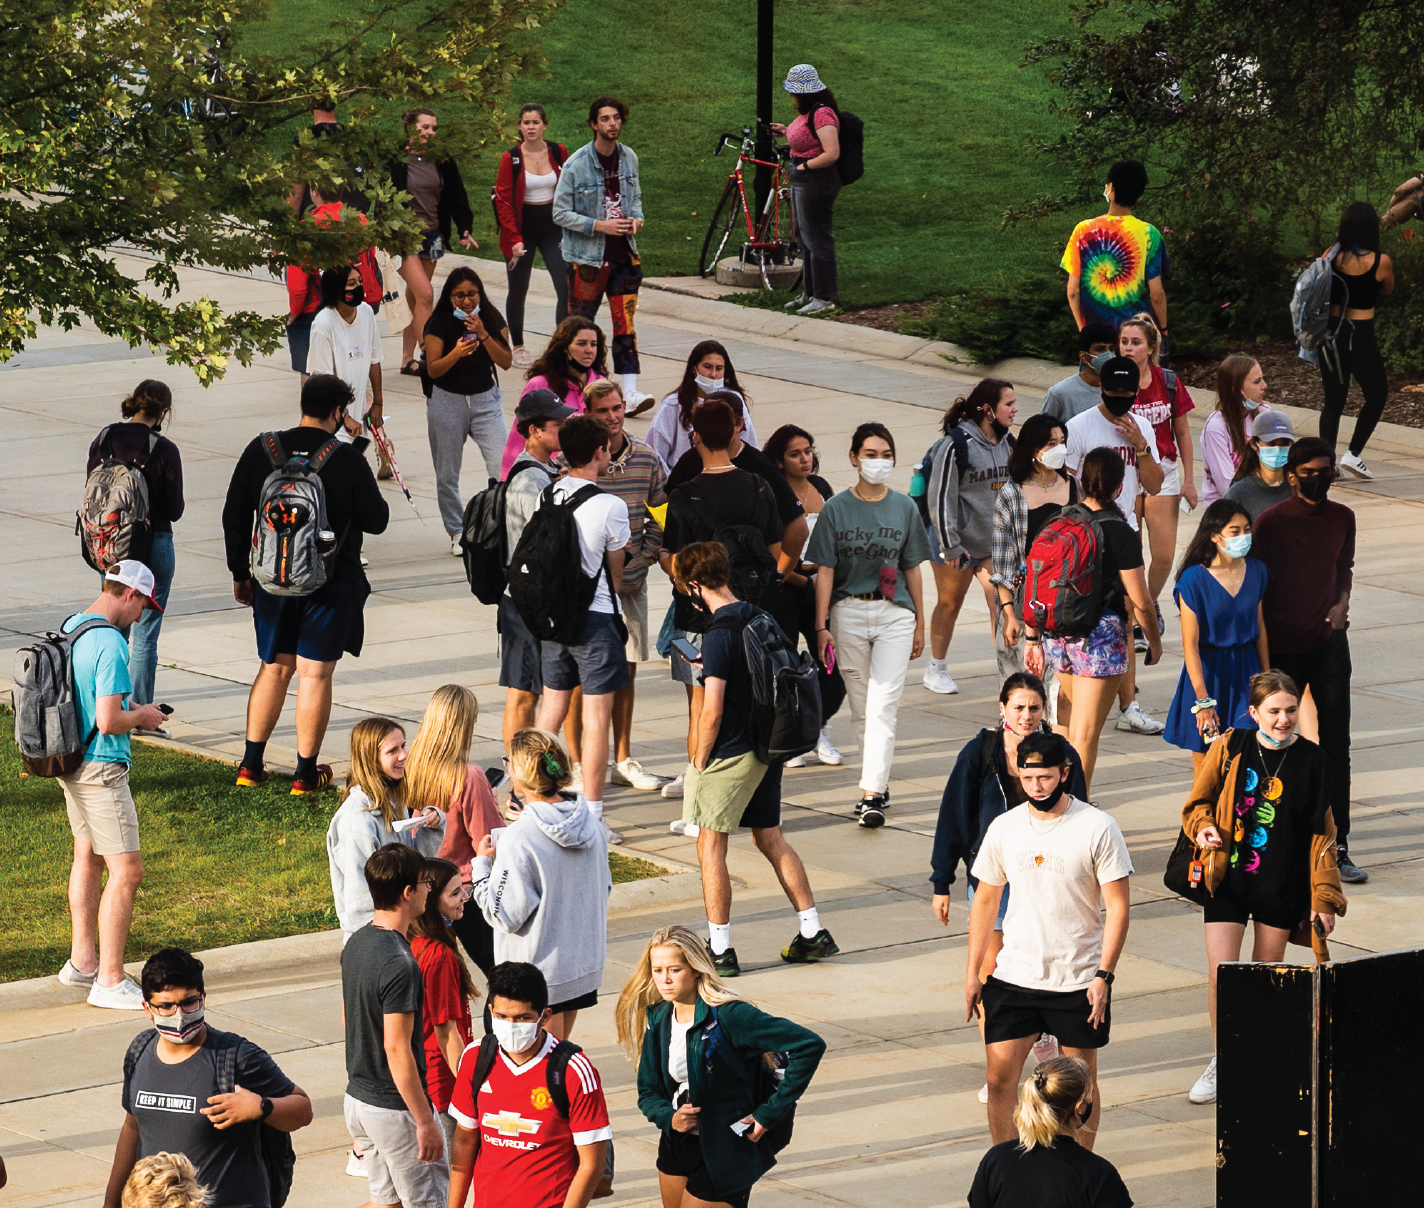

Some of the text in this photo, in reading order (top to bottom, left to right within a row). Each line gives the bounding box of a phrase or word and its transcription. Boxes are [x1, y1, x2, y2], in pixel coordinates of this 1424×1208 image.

[969, 466, 1010, 484] MARQUE
[836, 526, 902, 547] ucky me
[1015, 851, 1065, 875] VANS
[493, 869, 510, 918] WISCONSIN
[139, 1094, 193, 1111] KEEP IT SIMPLE
[483, 1134, 542, 1152] CHEVROLET
